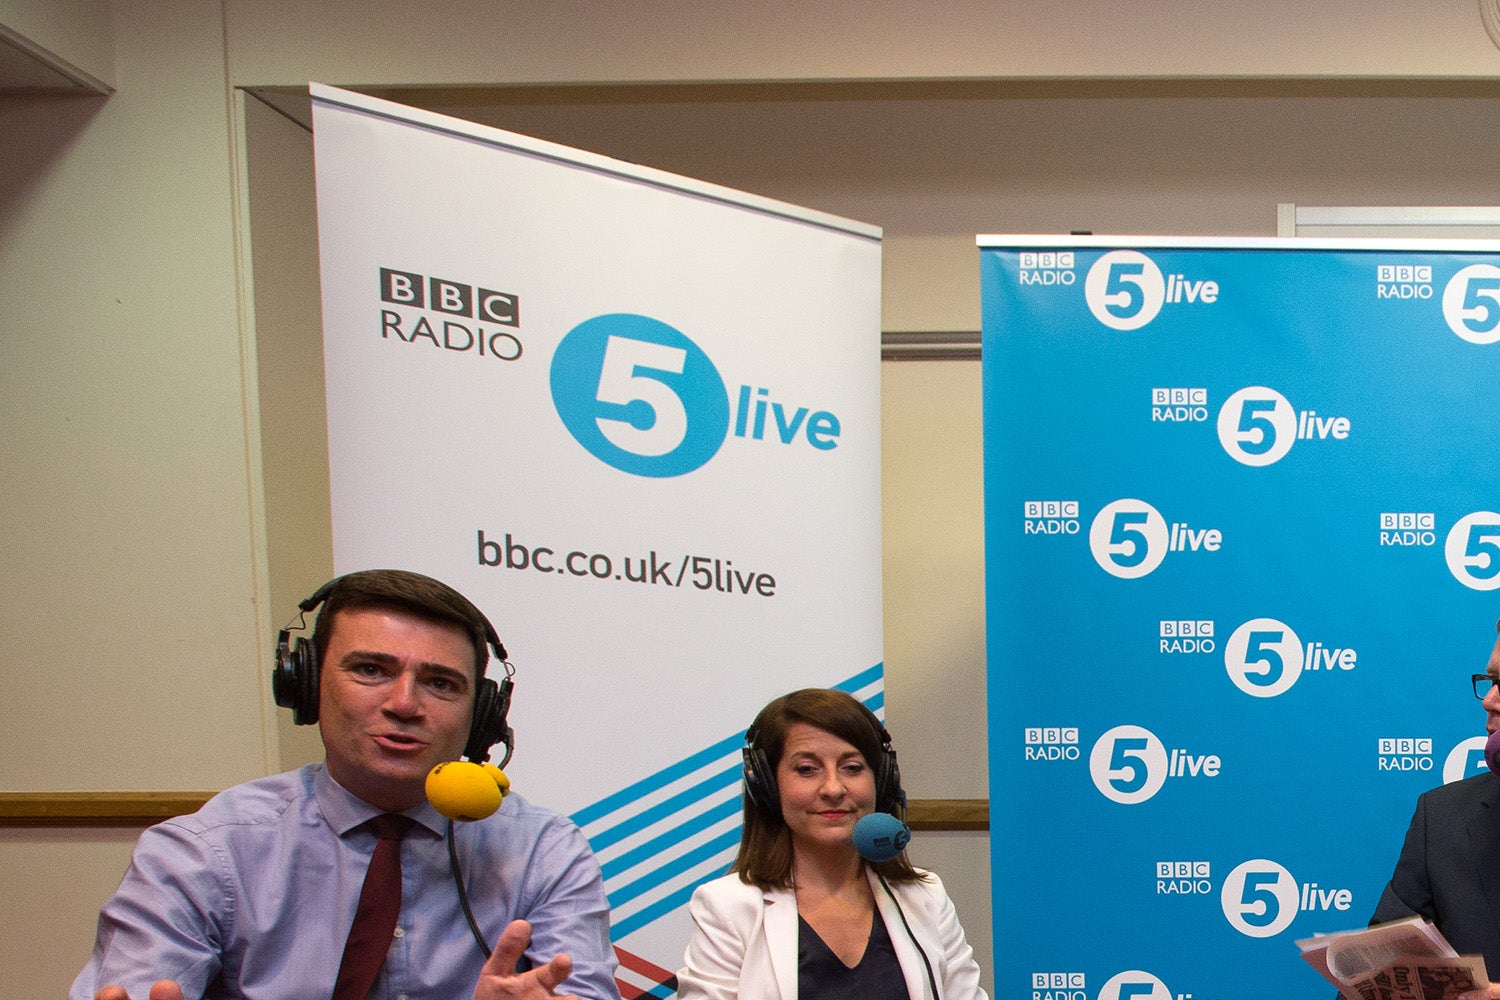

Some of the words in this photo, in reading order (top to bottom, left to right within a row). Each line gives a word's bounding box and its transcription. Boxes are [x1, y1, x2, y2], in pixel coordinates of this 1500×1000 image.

[1022, 253, 1073, 268] BBC
[1019, 269, 1076, 285] RADIO
[1380, 266, 1431, 281] BBC
[384, 271, 516, 325] BBC
[1104, 263, 1145, 320] 5
[1166, 274, 1218, 303] live
[1377, 283, 1434, 299] RADIO
[381, 310, 524, 362] RADIO
[594, 335, 688, 457] 5
[735, 385, 841, 451] live
[1154, 389, 1206, 404] BBC
[1151, 406, 1209, 422] RADIO
[1236, 399, 1277, 456] 5
[1298, 411, 1350, 439] live
[1027, 502, 1077, 517] BBC
[1024, 519, 1080, 535] RADIO
[1382, 514, 1433, 529] BBC
[1109, 512, 1149, 568] 5
[1170, 523, 1222, 551] live
[1379, 531, 1436, 546] RADIO
[477, 529, 776, 596] bbc.co.uk/5live
[1162, 622, 1213, 636] BBC
[1159, 639, 1215, 654] RADIO
[1244, 631, 1284, 687] 5
[1305, 643, 1356, 670] live
[1027, 729, 1077, 743] BBC
[1025, 746, 1080, 761] RADIO
[1381, 740, 1431, 753] BBC
[1109, 738, 1149, 794] 5
[1170, 749, 1221, 776] live
[1378, 756, 1434, 771] RADIO
[1159, 863, 1209, 877] BBC
[1156, 879, 1212, 894] RADIO
[1240, 872, 1279, 927] 5
[1301, 883, 1352, 910] live
[1035, 974, 1084, 987] BBC
